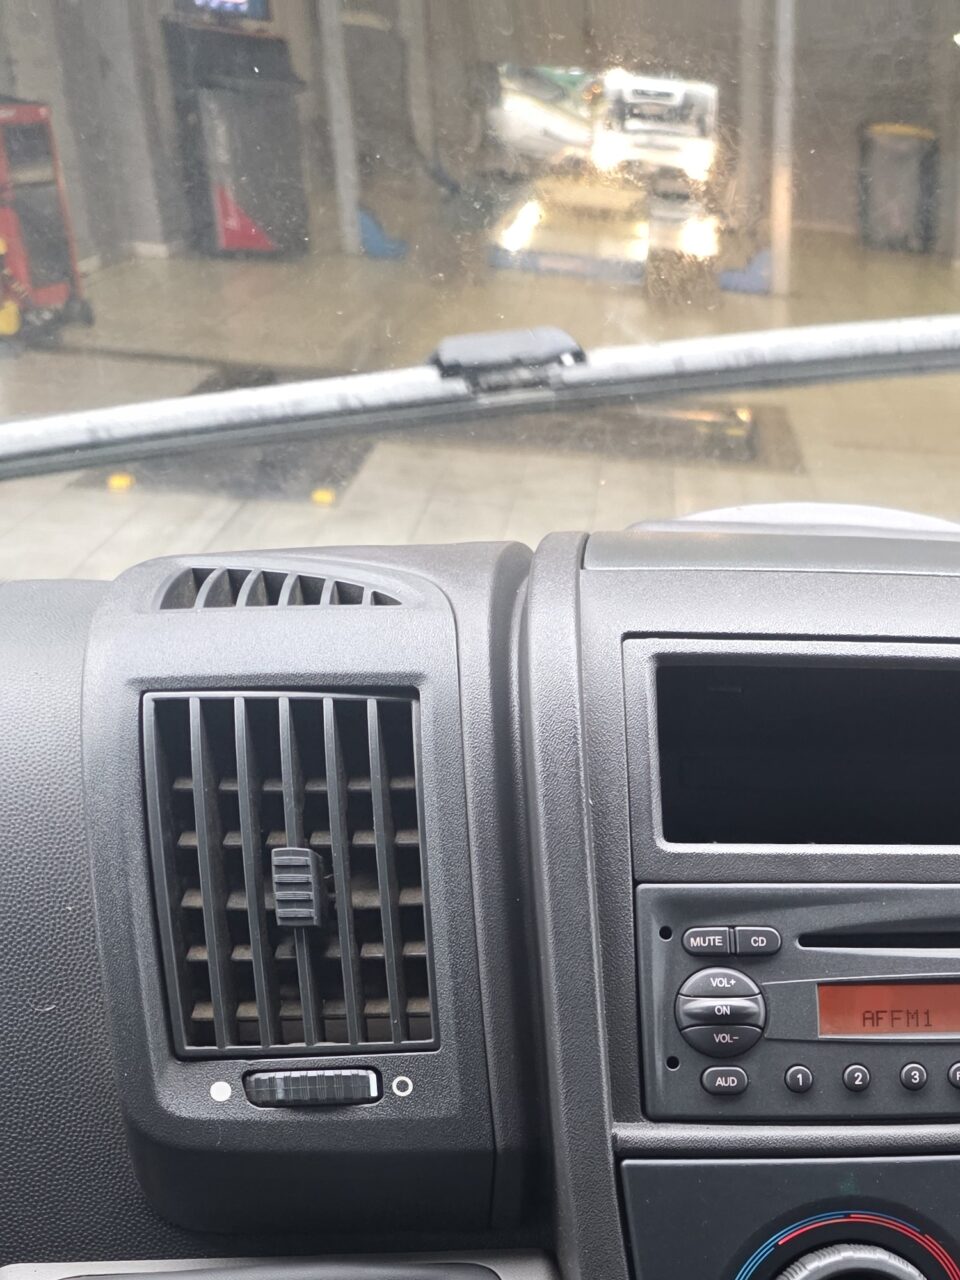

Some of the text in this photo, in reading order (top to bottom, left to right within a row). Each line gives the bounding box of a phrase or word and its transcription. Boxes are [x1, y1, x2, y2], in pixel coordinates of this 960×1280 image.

[690, 936, 723, 947] MUTE
[750, 936, 767, 947] CD
[715, 1005, 730, 1016] ON
[715, 1077, 738, 1088] AUD
[796, 1074, 803, 1086] 1
[854, 1073, 863, 1085] 2
[910, 1071, 920, 1083] 3
